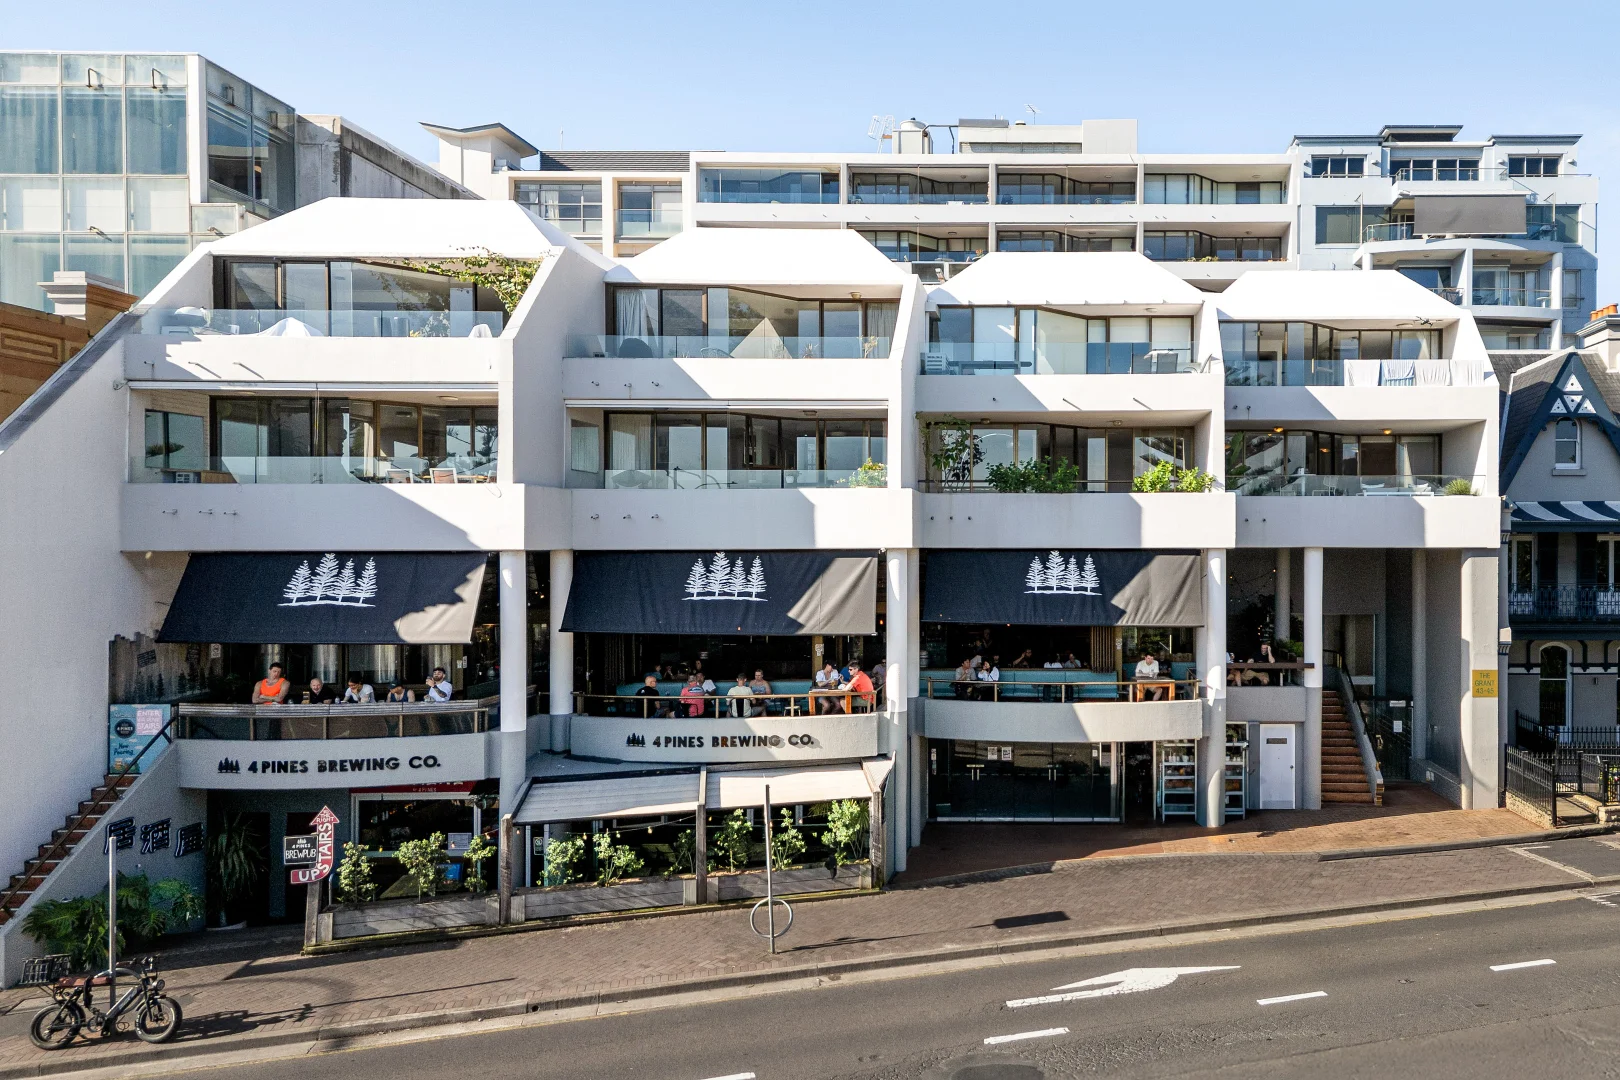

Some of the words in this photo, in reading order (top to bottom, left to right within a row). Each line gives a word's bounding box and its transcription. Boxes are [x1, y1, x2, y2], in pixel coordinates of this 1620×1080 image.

[652, 736, 662, 748] 4
[664, 736, 704, 748] PINES
[711, 735, 781, 748] BREWING
[787, 733, 815, 746] CO.
[247, 760, 258, 774] 4
[261, 760, 309, 774] PINES
[317, 756, 400, 773] BREWING
[408, 755, 441, 769] CO.
[285, 848, 317, 859] BREWPUB
